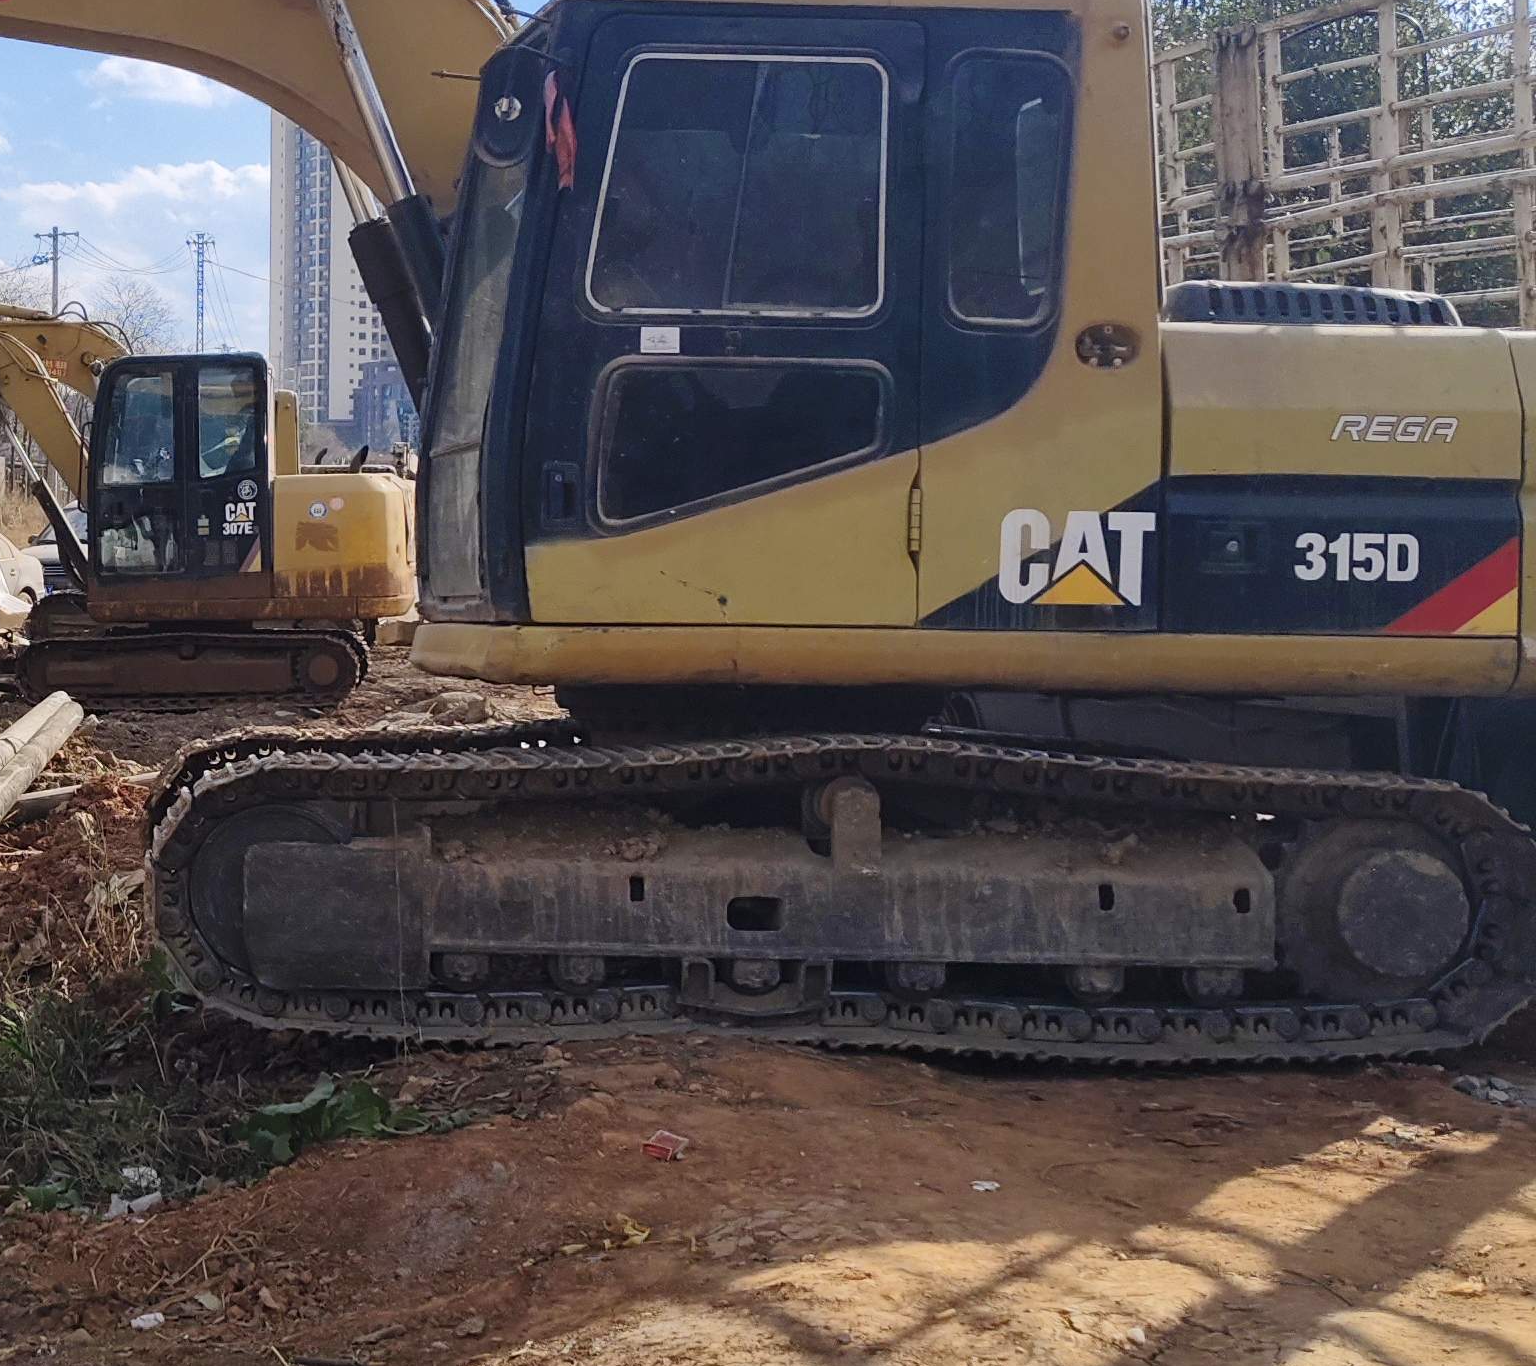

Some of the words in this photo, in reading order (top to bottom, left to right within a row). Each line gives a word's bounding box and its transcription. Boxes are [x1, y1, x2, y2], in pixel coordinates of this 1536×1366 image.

[1329, 414, 1459, 444] REGA
[225, 502, 257, 522] CAT
[222, 521, 254, 536] 307E
[998, 508, 1157, 606] CAT
[1293, 532, 1420, 582] 315D
